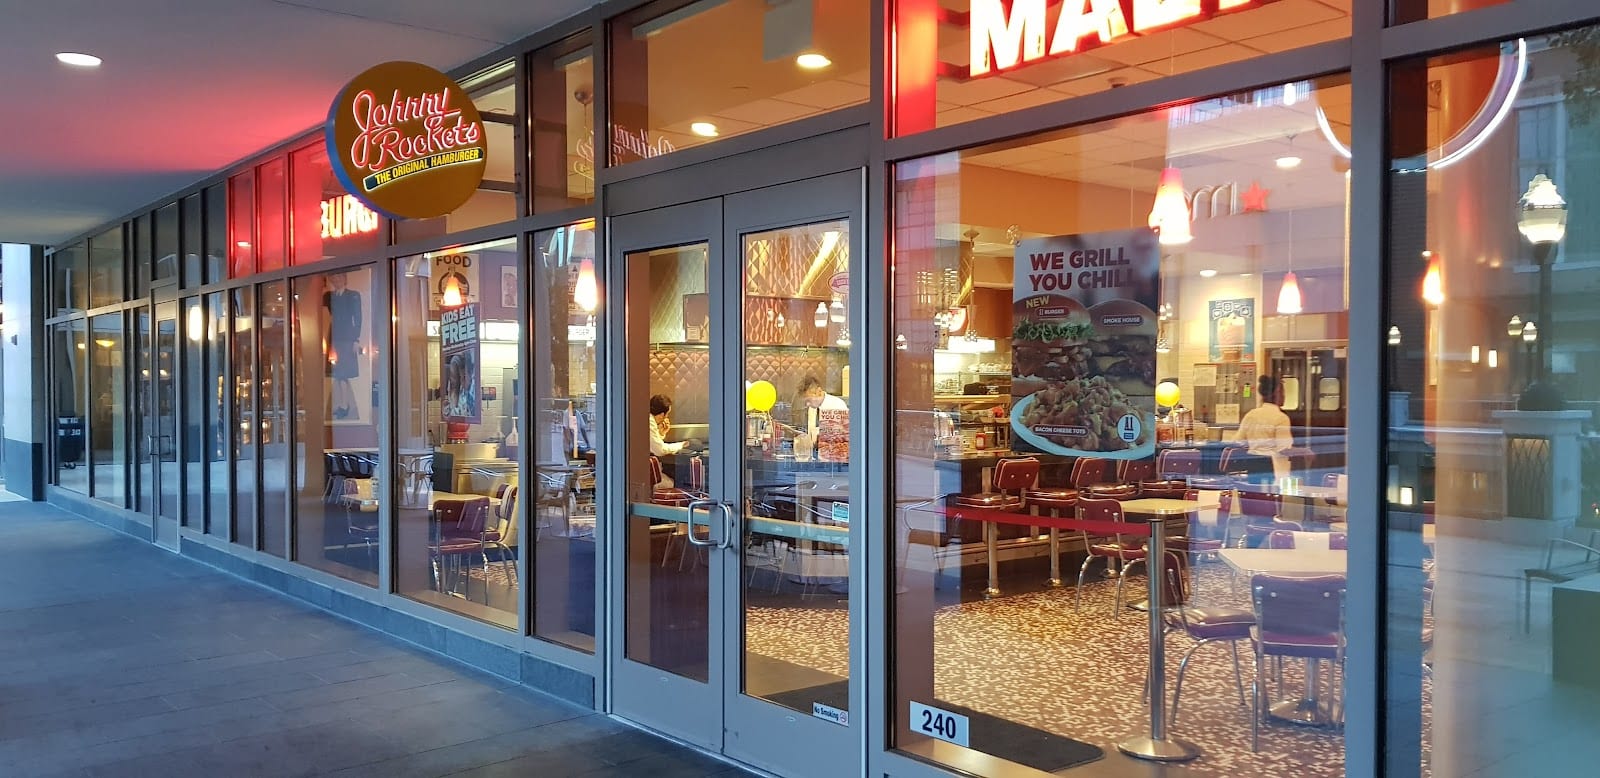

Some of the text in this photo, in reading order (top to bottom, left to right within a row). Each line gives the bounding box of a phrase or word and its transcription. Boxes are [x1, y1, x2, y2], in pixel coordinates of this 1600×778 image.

[351, 87, 461, 169] Johnny
[369, 115, 481, 171] Rockets
[374, 149, 479, 185] THE ORIGINAL HAMBURGER
[435, 254, 472, 268] FOOD
[1030, 246, 1130, 271] WE GRILL
[1028, 268, 1136, 292] YOU CHILL
[441, 303, 475, 325] KIDS EAT
[1025, 295, 1050, 308] NEW
[441, 316, 477, 346] FREE
[921, 709, 957, 740] 240
